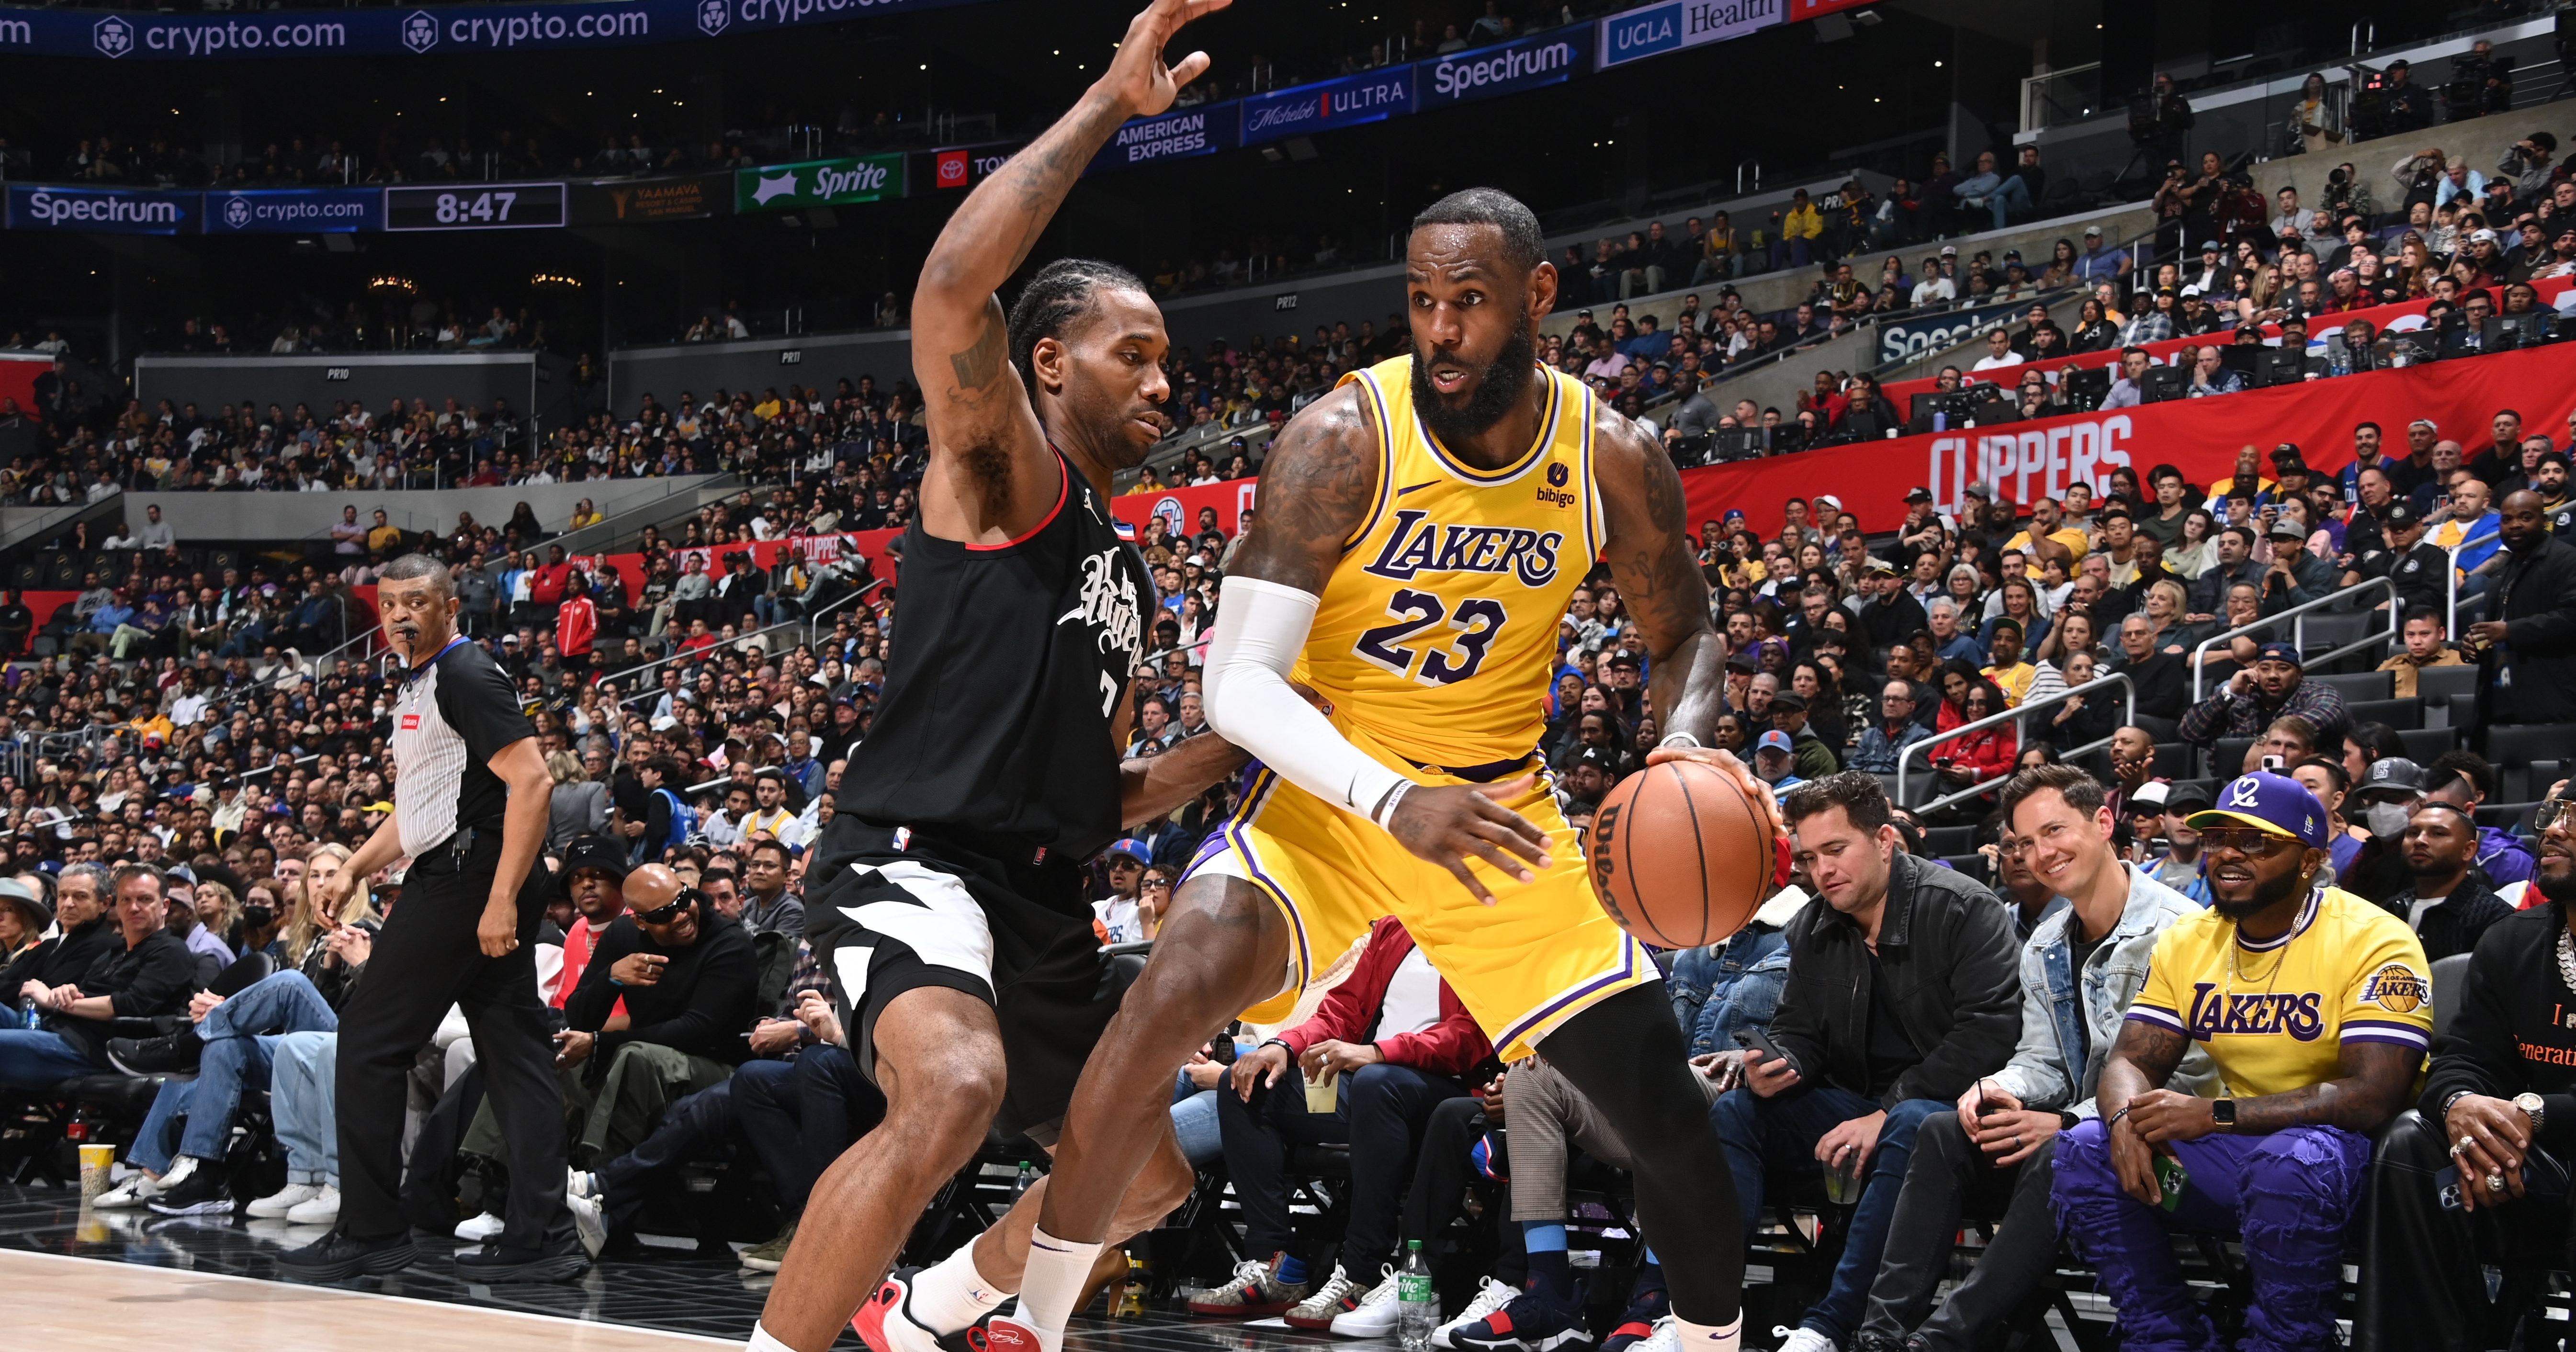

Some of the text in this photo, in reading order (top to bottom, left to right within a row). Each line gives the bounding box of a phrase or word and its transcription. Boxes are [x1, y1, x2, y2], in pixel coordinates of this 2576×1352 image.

[147, 21, 345, 55] crypto.com
[451, 11, 648, 47] crypto.com
[1618, 17, 1672, 50] UCLA
[1435, 42, 1568, 99] Spectrum
[1248, 82, 1404, 132] Michelob ULTRA
[1116, 113, 1204, 146] AMERICAN
[1129, 132, 1206, 162] EXPRESS
[812, 162, 887, 200] Sprite
[31, 192, 176, 225] Spectrum
[256, 201, 364, 221] crypto.com
[436, 192, 517, 223] 8:47
[1823, 194, 1844, 211] PR1
[1277, 295, 1297, 310] PR12
[782, 351, 801, 363] PR11
[328, 368, 349, 380] PR10
[1930, 415, 2132, 515] CLIPPERS
[1537, 487, 1575, 508] bibigo
[1361, 509, 1565, 588] LAKERS
[1351, 587, 1508, 688] 23
[402, 718, 417, 727] Emirates
[1593, 802, 1631, 927] Wilson
[2362, 976, 2431, 1004] LAKERS
[2400, 976, 2427, 984] ANGELES
[2188, 981, 2326, 1043] LAKERS
[2552, 1003, 2562, 1026] I
[2513, 1034, 2576, 1066] enerati
